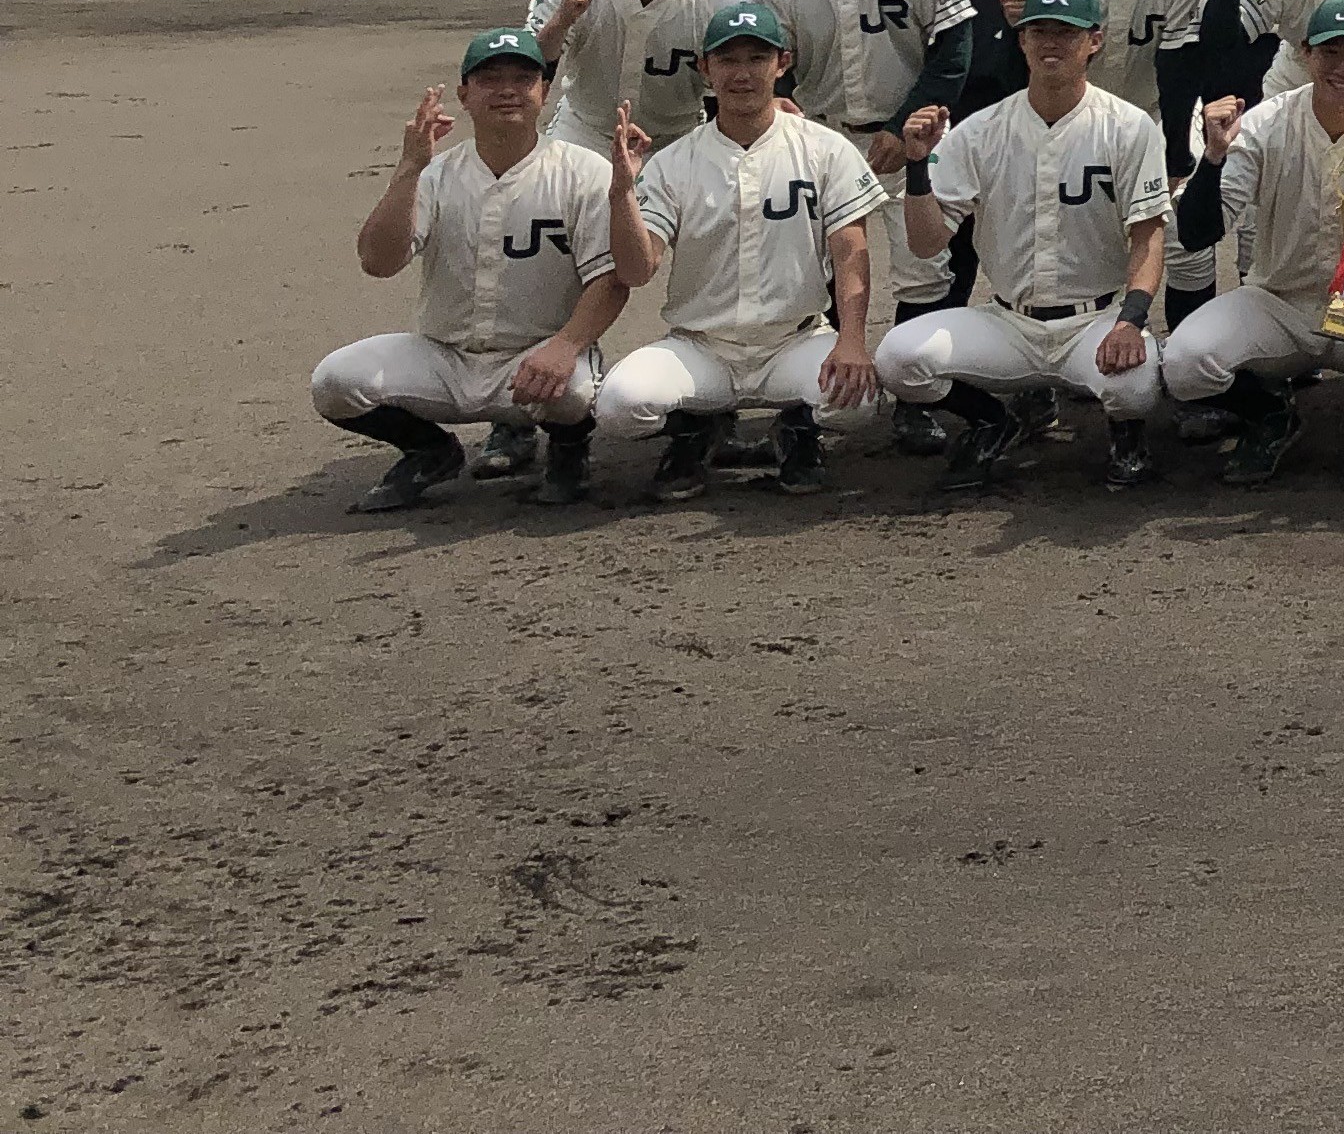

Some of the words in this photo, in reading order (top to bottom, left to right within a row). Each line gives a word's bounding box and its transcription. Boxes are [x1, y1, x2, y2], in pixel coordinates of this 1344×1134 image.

[728, 12, 758, 27] JR
[488, 34, 520, 49] JR
[645, 48, 699, 76] JR
[1059, 165, 1116, 205] JR
[1143, 178, 1162, 193] EAST
[762, 179, 819, 220] JR
[503, 219, 572, 259] JR
